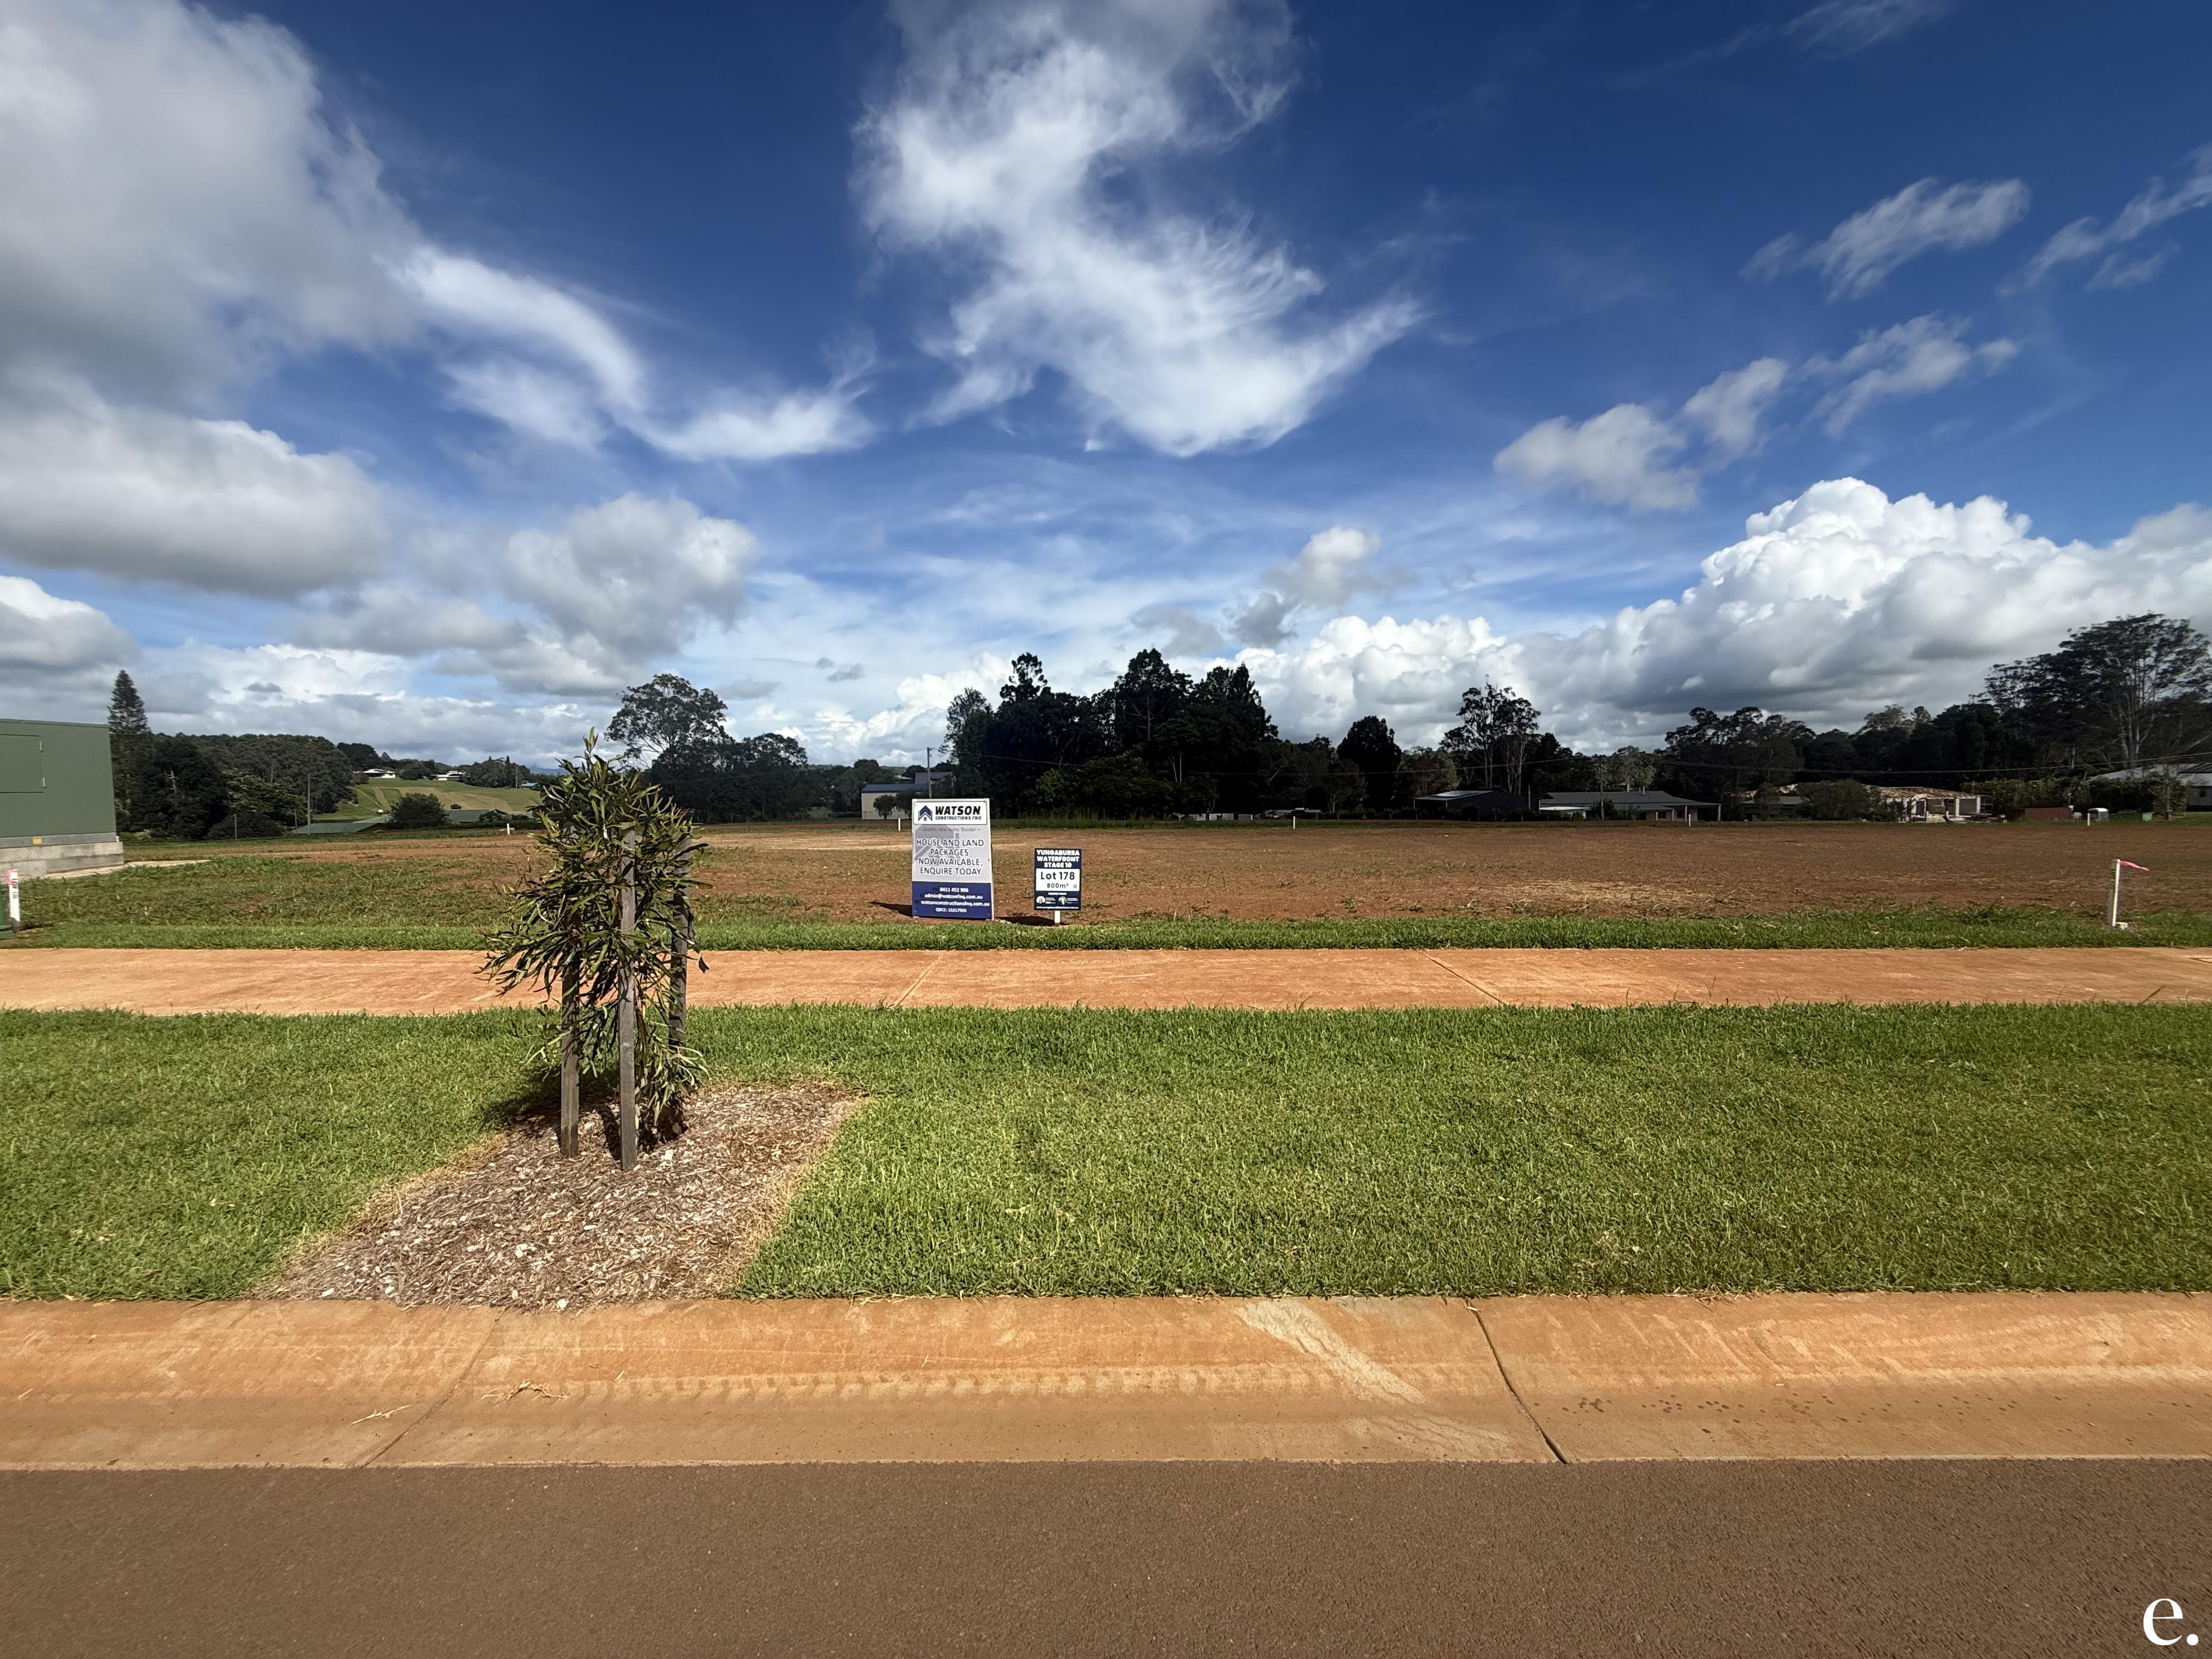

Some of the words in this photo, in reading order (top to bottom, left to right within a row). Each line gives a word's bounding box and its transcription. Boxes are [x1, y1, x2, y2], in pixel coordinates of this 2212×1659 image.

[935, 806, 981, 815] WATSON
[939, 858, 983, 867] AVAILABLE,
[920, 867, 953, 875] ENQUIRE
[1041, 871, 1057, 880] Lot
[1059, 871, 1075, 881] 178
